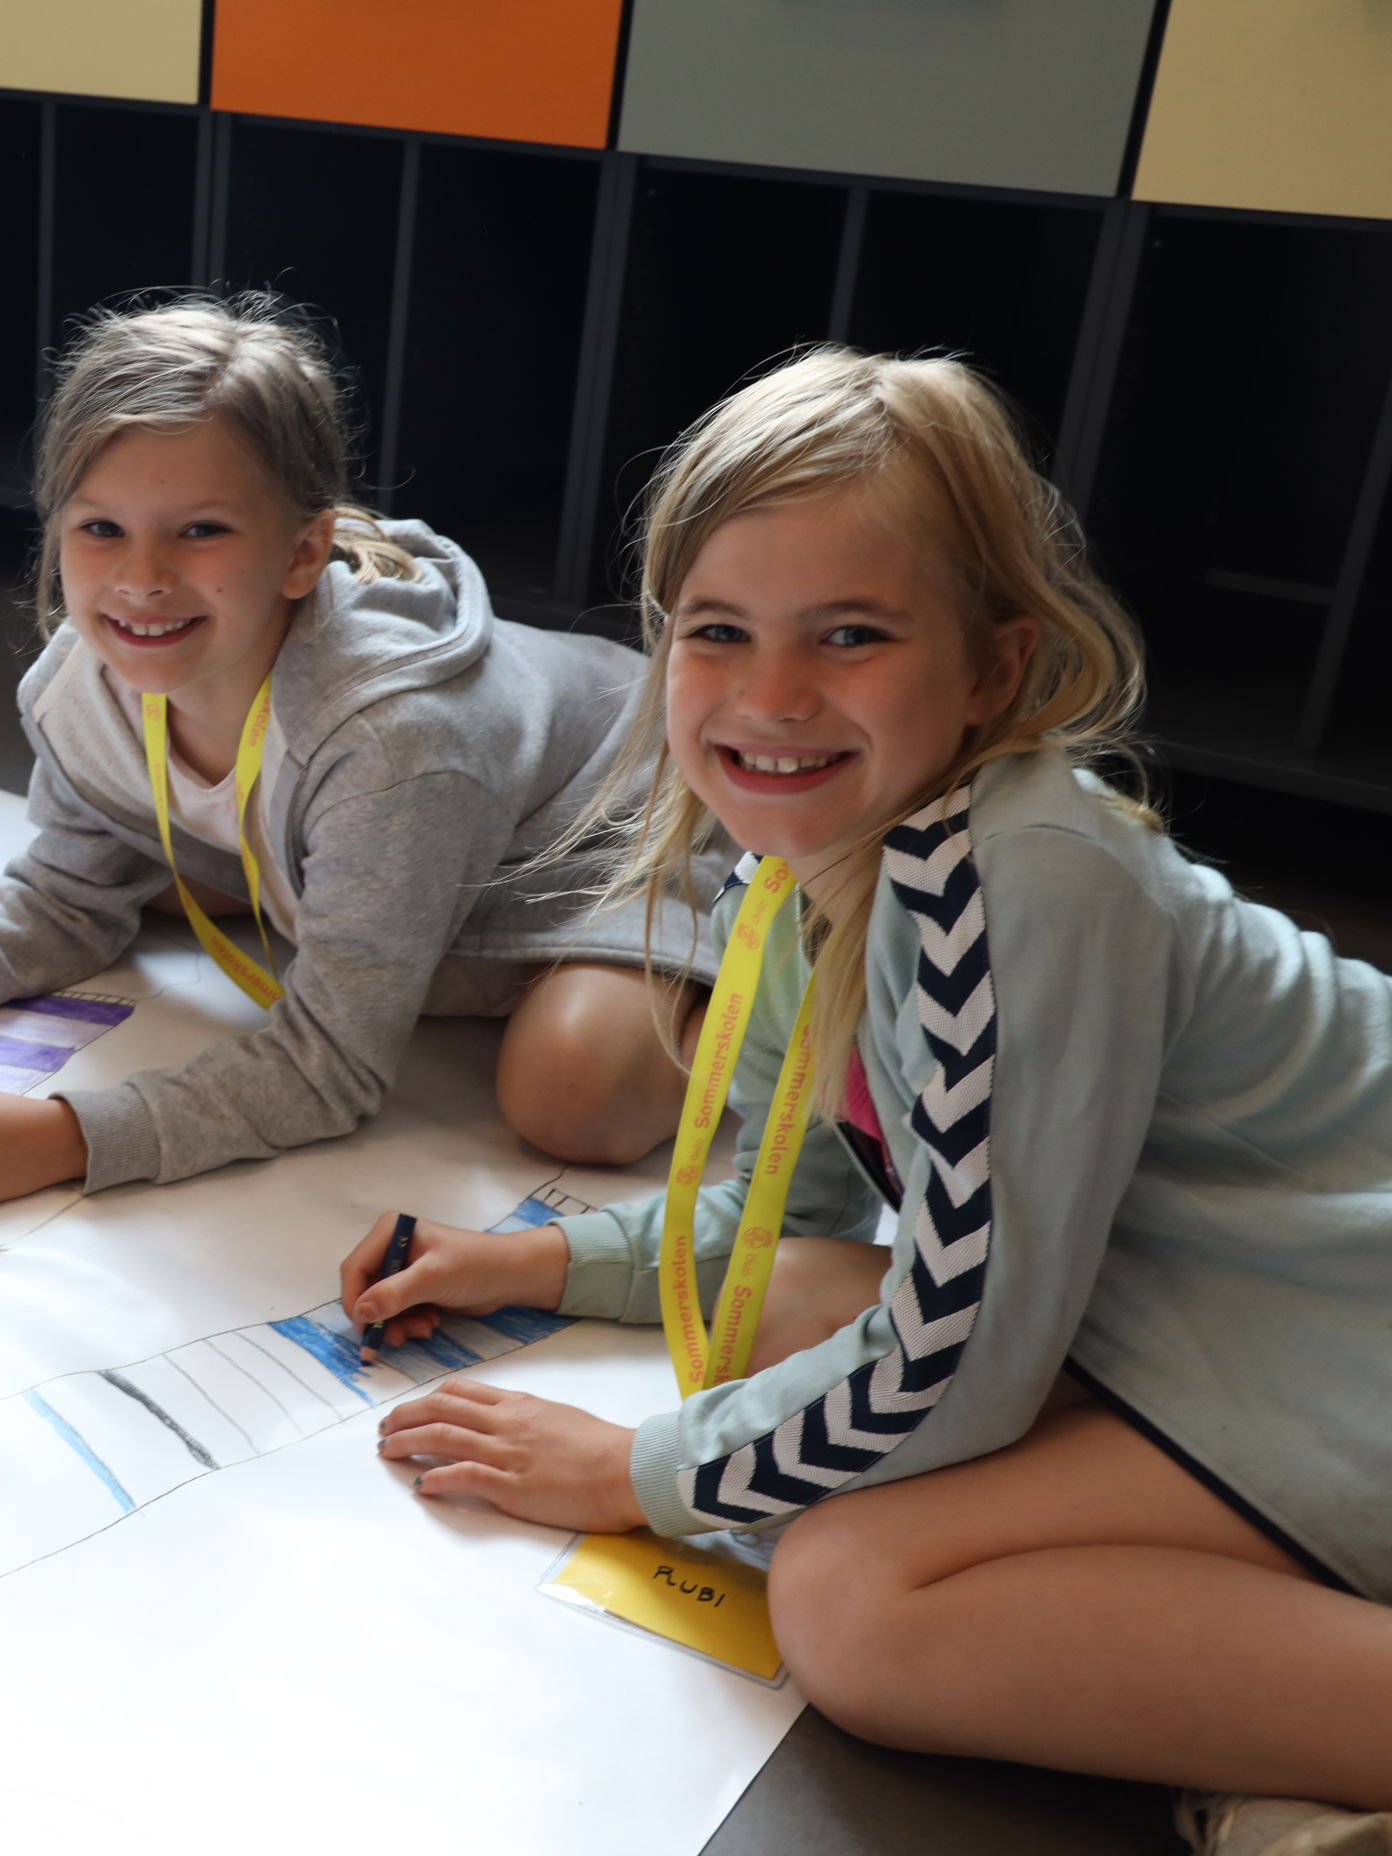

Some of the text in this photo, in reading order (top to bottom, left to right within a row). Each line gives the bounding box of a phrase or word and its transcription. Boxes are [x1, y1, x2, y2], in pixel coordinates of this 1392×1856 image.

[694, 991, 745, 1130] Sommerskolen
[671, 1233, 706, 1386] Sommerskolen
[713, 1284, 753, 1387] Sommersk
[652, 1565, 727, 1608] RUBI
